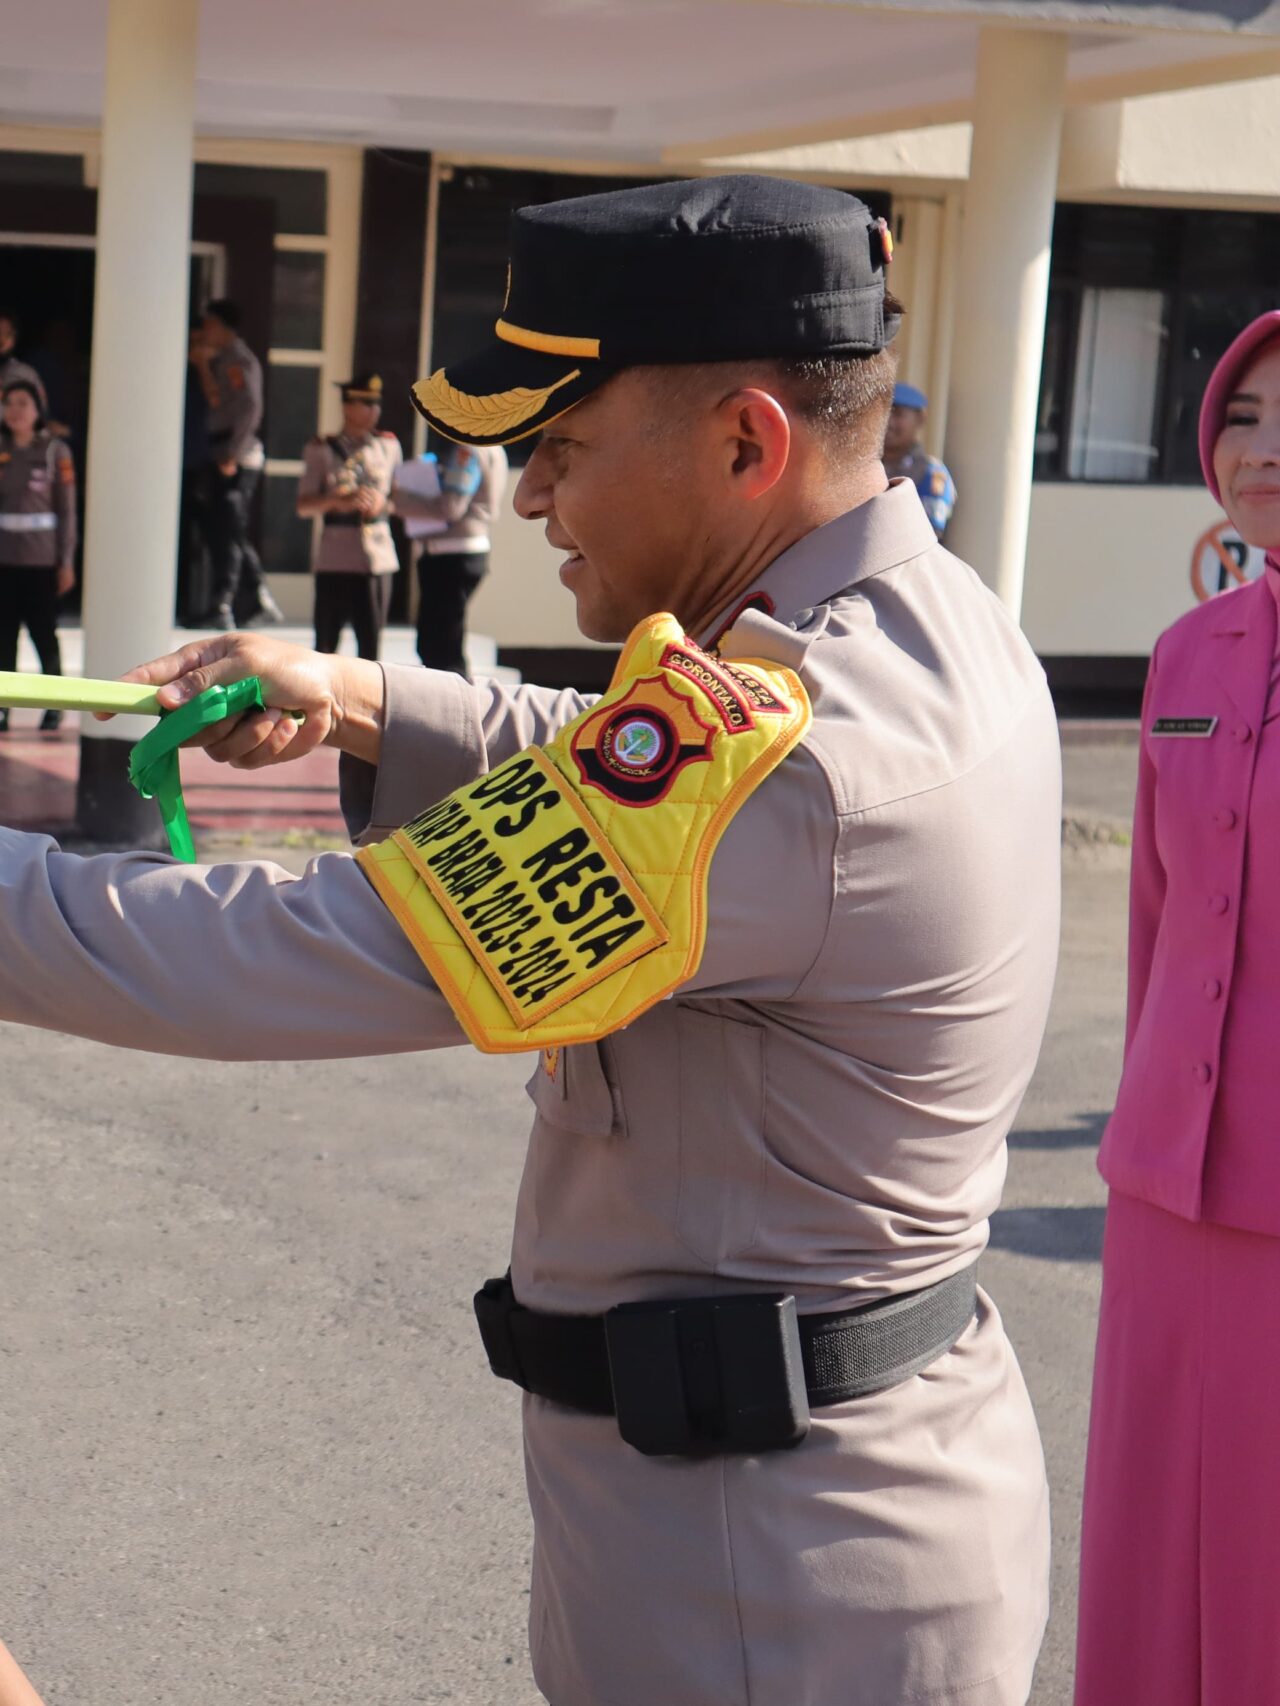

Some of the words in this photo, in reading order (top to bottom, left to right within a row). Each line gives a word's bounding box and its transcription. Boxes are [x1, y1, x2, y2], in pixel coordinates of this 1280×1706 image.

[668, 653, 744, 727] GORONTALO
[427, 828, 507, 905] BRATA
[470, 758, 561, 838] OPS
[522, 828, 645, 969] RESTA
[461, 884, 578, 1008] 2023-2024
